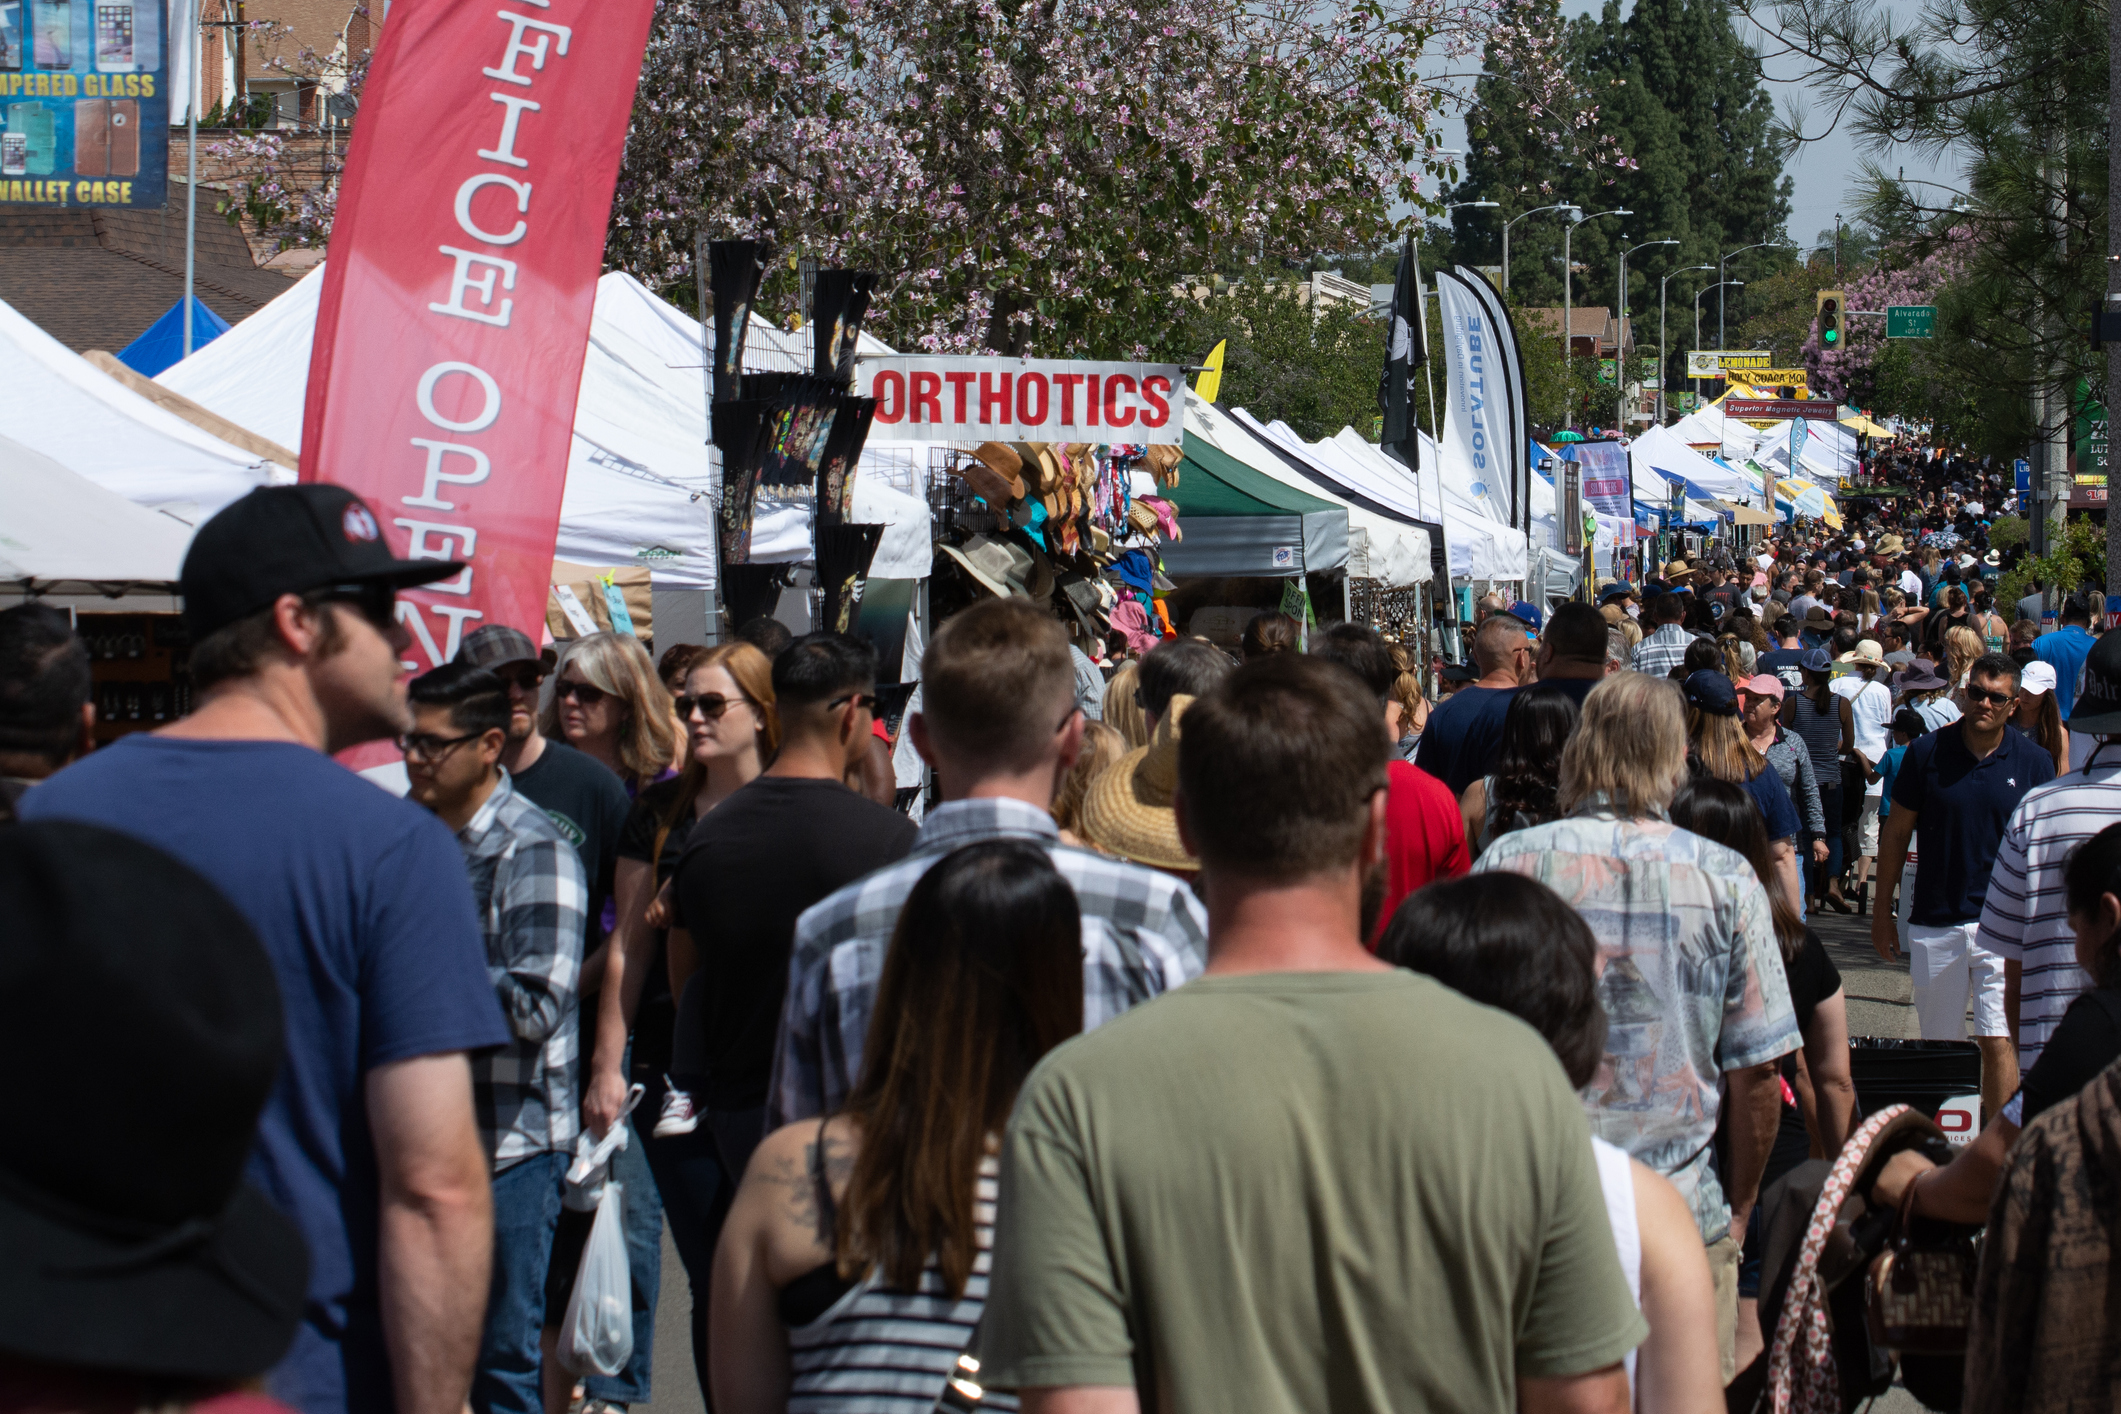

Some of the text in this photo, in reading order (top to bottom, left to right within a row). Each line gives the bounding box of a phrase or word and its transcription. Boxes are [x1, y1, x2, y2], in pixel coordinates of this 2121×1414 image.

[84, 74, 155, 97] GLASS
[428, 0, 571, 327] FICE
[75, 181, 132, 203] CASE
[1894, 309, 1930, 318] Alvarado
[1908, 319, 1917, 327] St
[1718, 357, 1769, 368] LEMONADE
[1728, 372, 1750, 382] HOLY
[872, 370, 1172, 428] ORTHOTICS
[1729, 404, 1833, 415] Superior Magnetic Jewelry
[1590, 482, 1618, 494] SOLD HERE
[393, 361, 501, 671] OPEN
[1283, 598, 1304, 618] SPON
